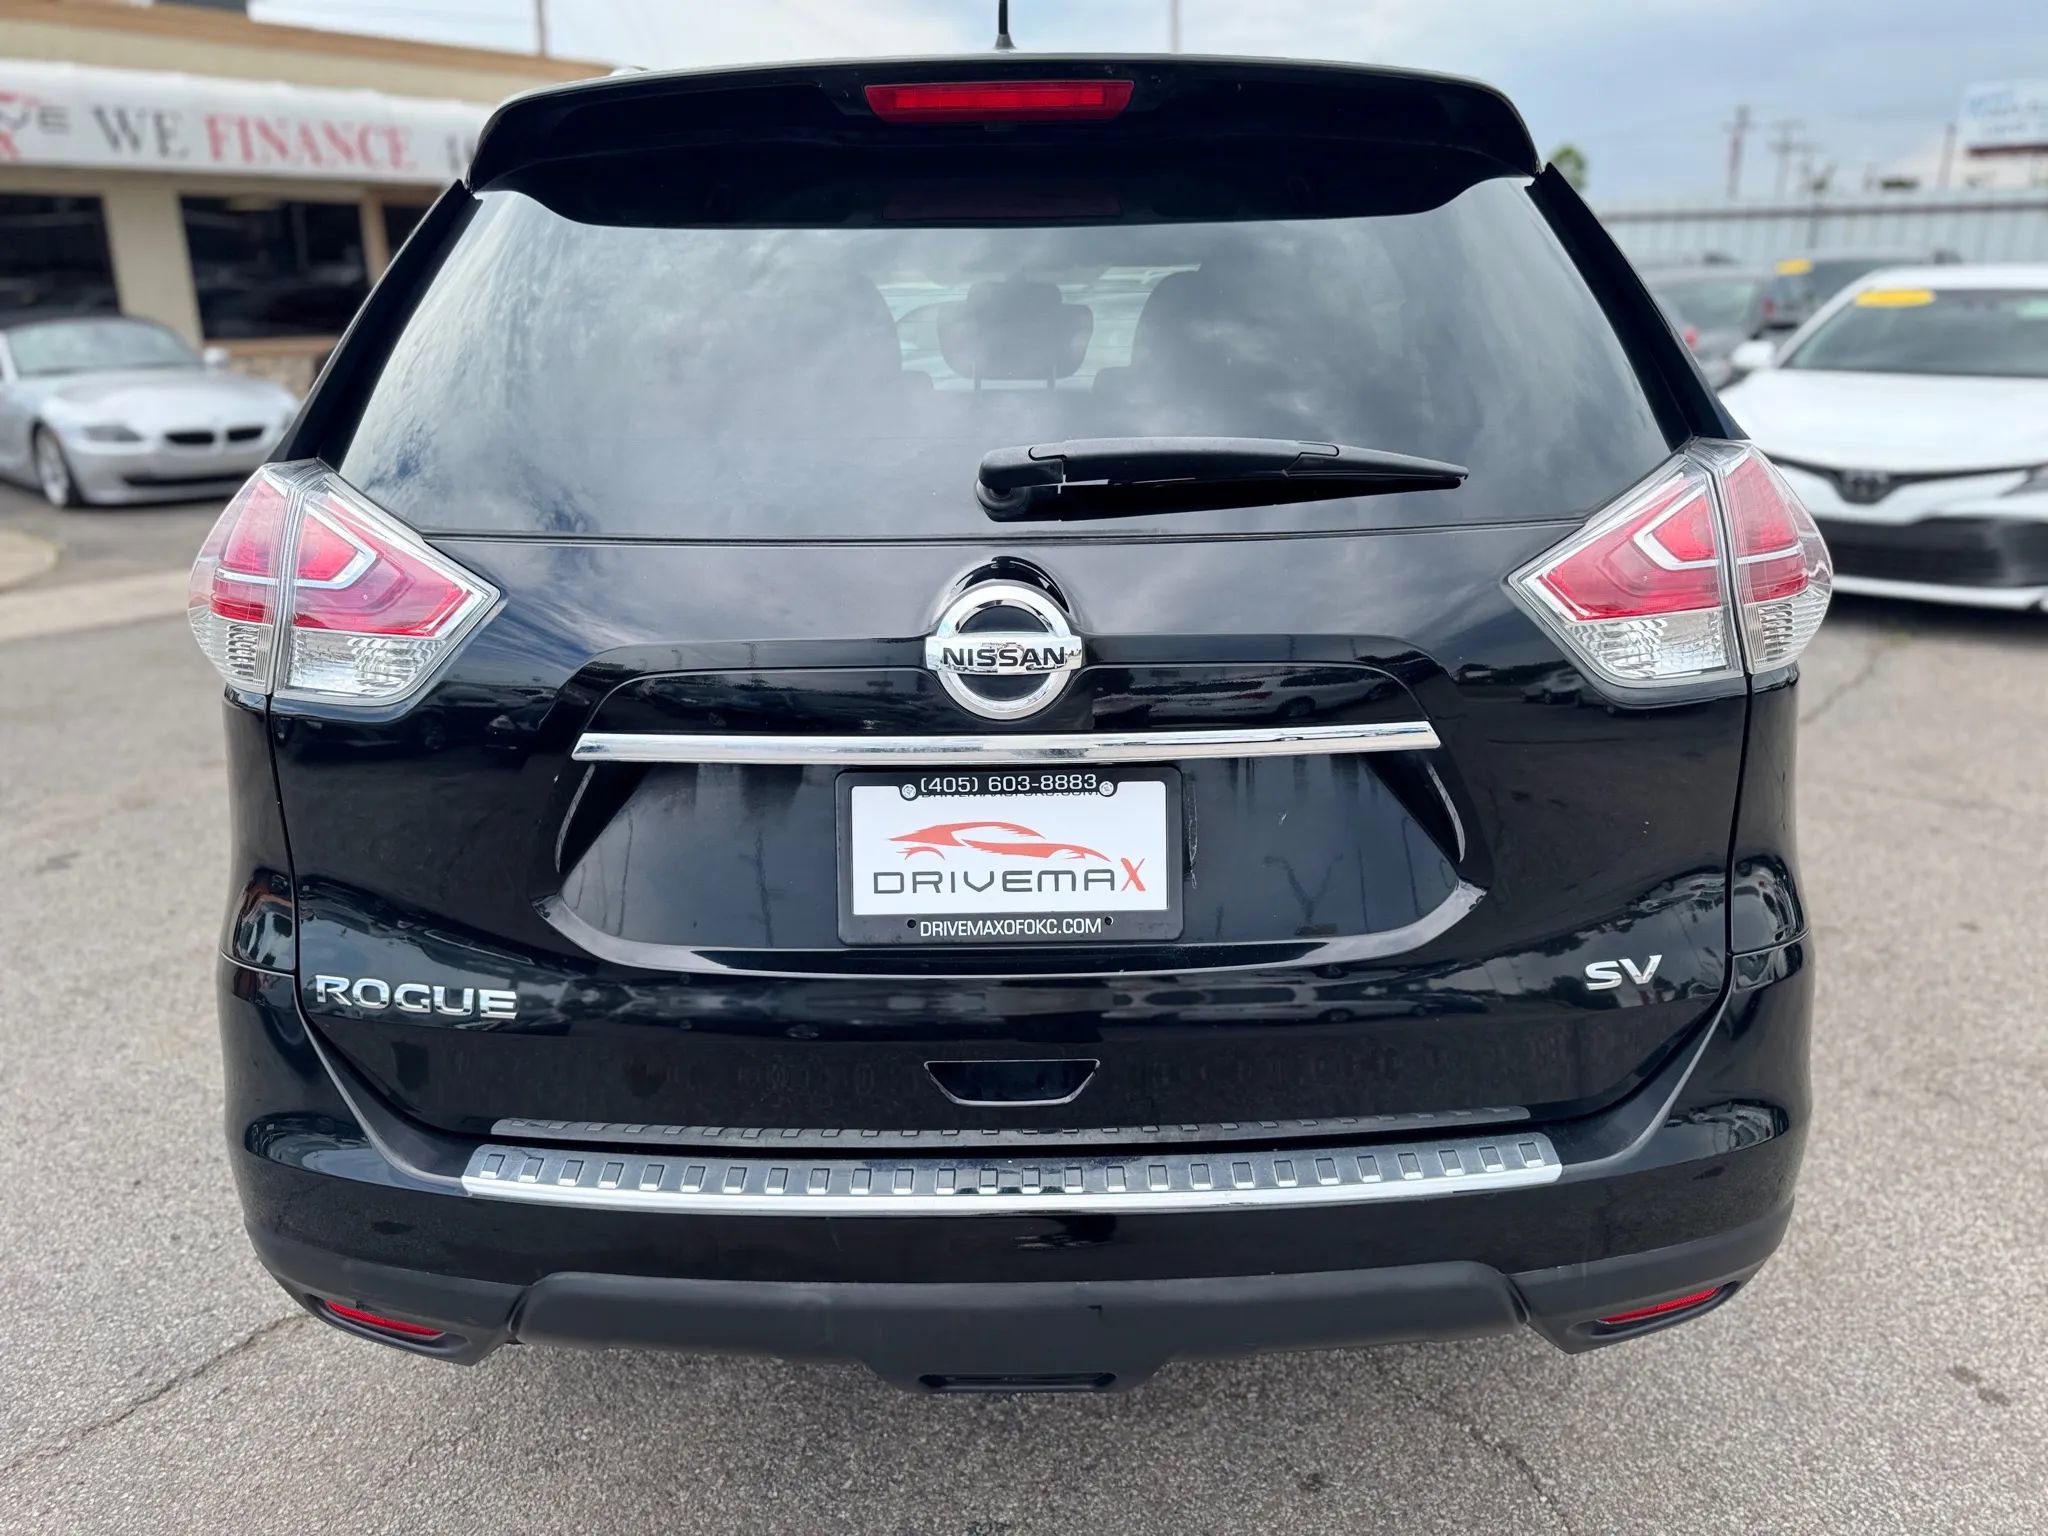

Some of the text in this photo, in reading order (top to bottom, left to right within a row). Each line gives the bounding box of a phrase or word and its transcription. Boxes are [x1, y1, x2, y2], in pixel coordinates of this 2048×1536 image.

[93, 104, 188, 158] WE
[205, 112, 416, 170] FINANCE
[943, 646, 1065, 667] NISSAN
[920, 773, 1097, 793] (405) 603-8883
[873, 857, 1146, 894] DRIVEMAX
[920, 917, 1102, 937] DRIVEMAXOFOKC.COM
[1585, 954, 1663, 991] SV
[315, 974, 517, 1020] ROGUE
